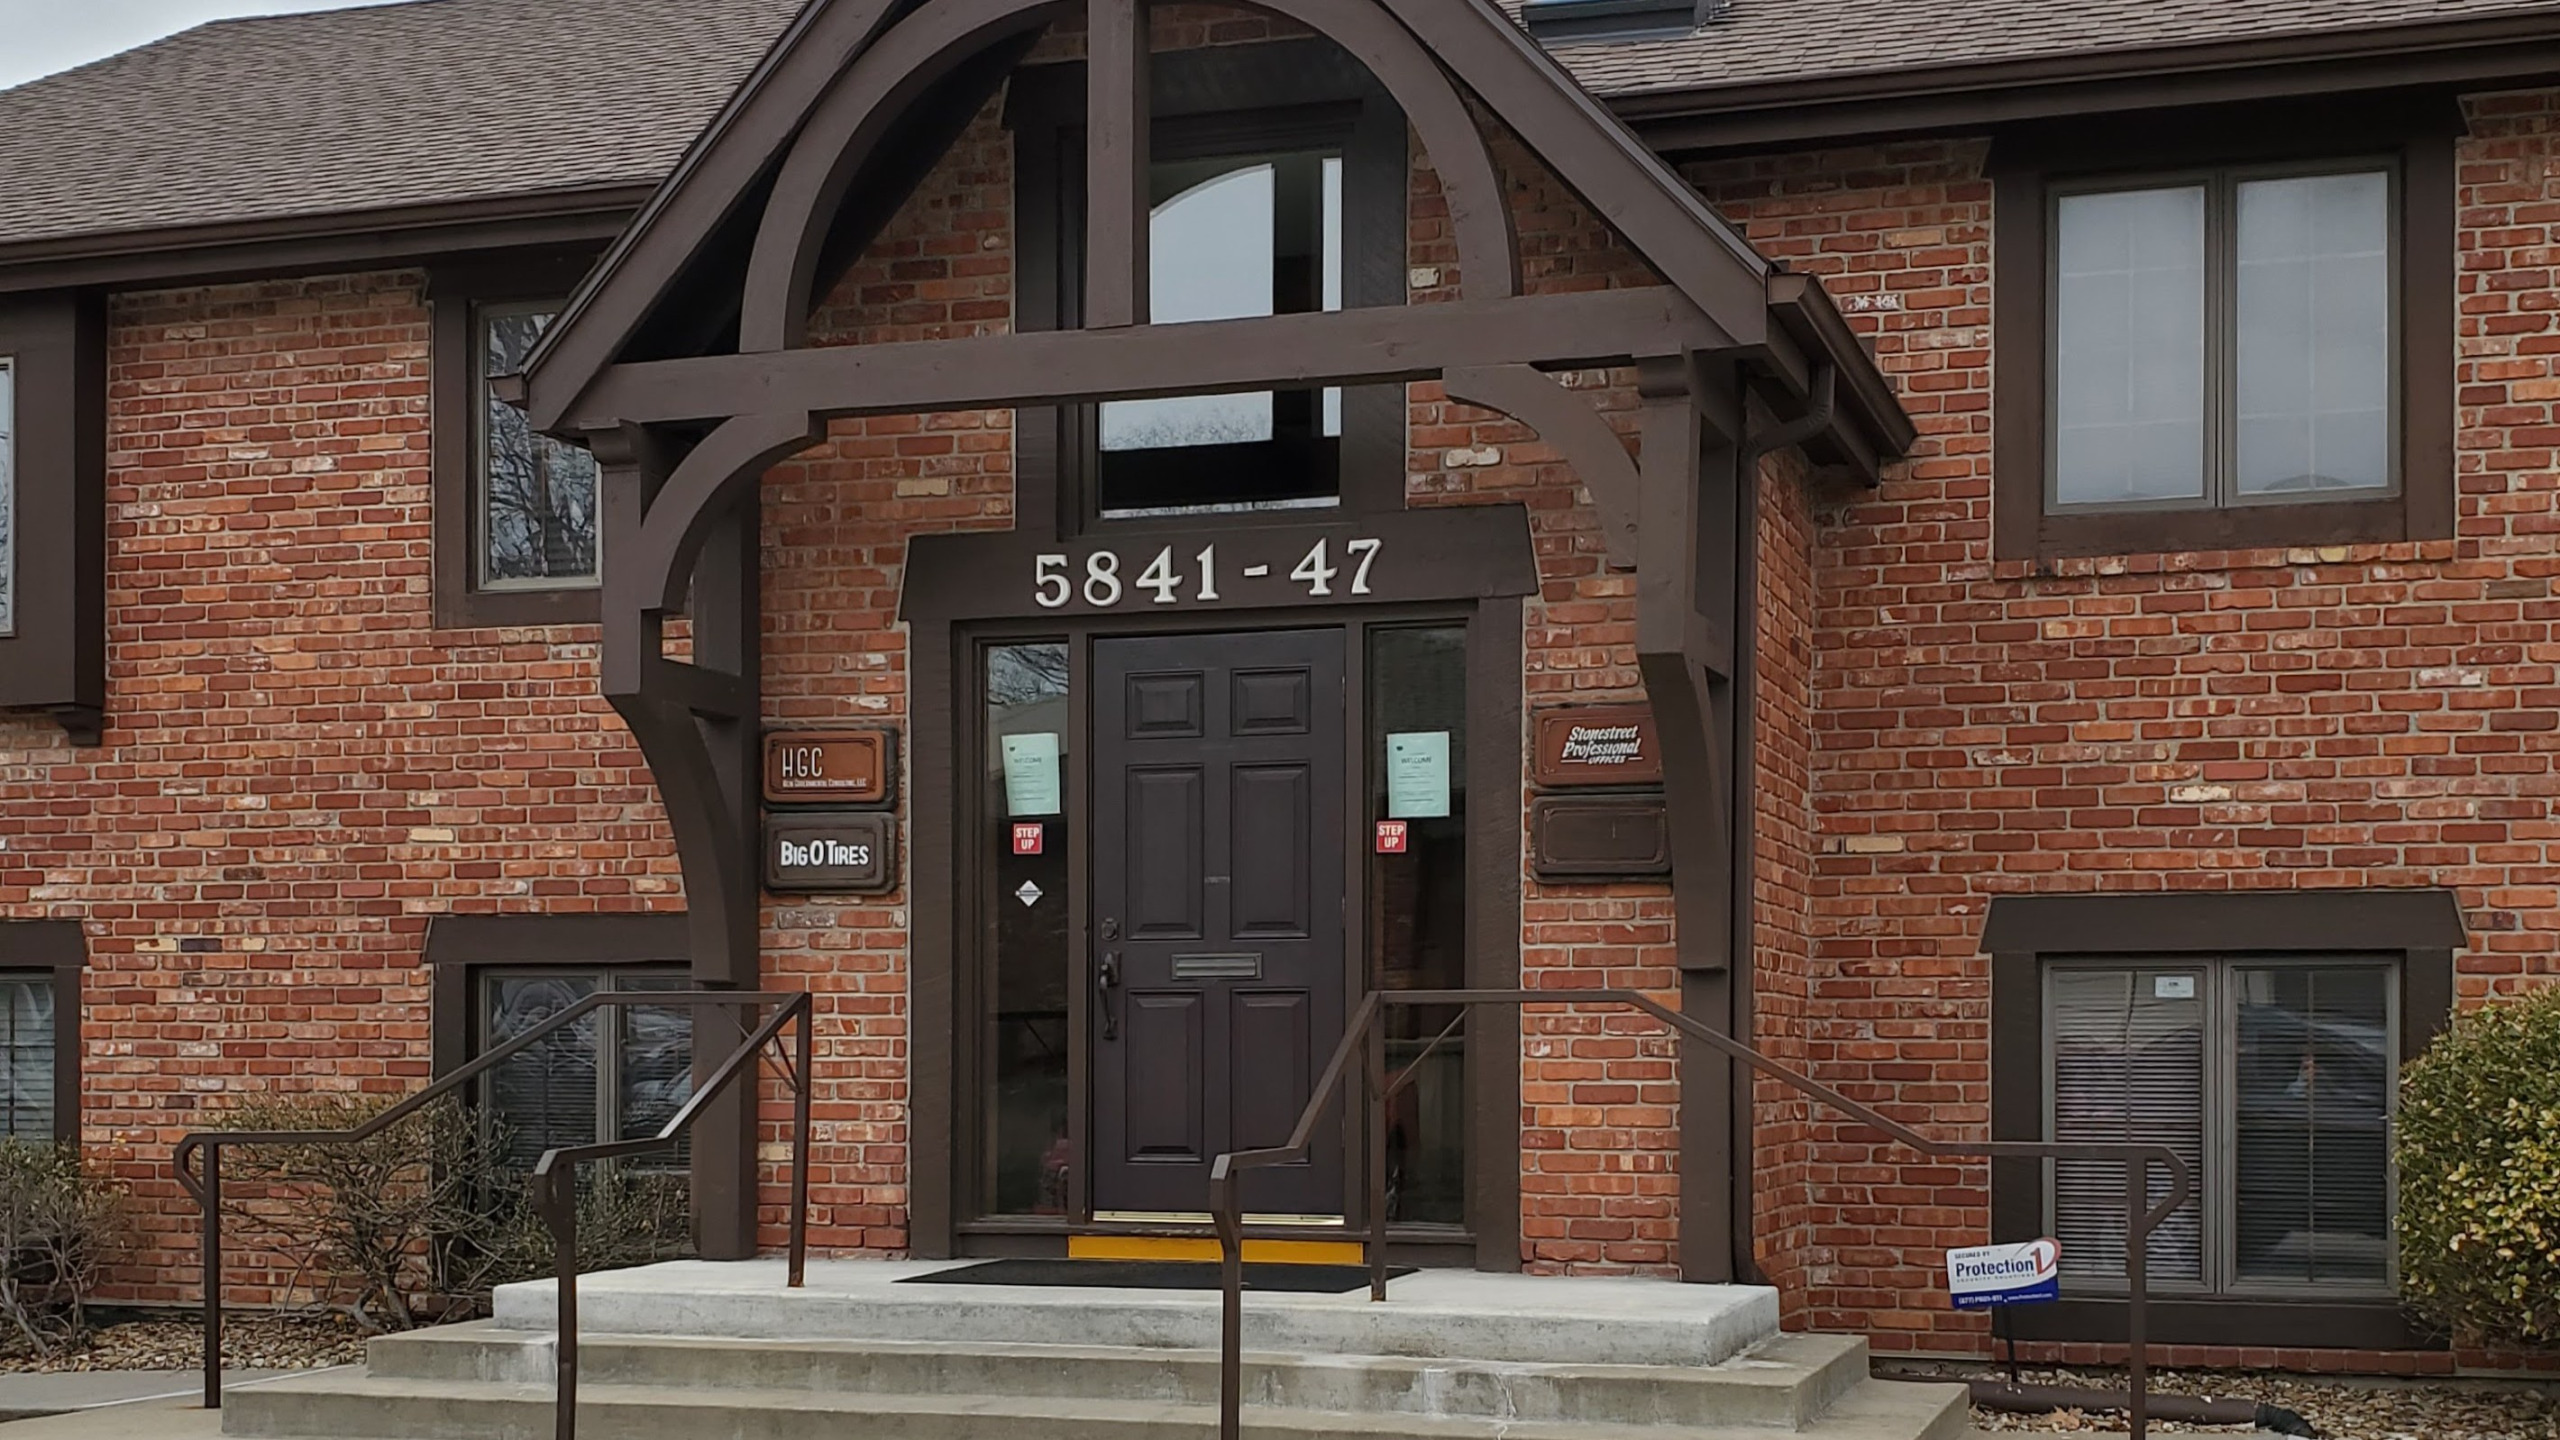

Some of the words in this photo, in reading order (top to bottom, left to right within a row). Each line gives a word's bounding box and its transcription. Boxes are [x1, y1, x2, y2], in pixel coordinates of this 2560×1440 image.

[1569, 725, 1638, 741] Stonestreet
[1562, 737, 1641, 759] Professional
[781, 747, 823, 777] HGC
[1588, 755, 1625, 765] OFFICES
[1015, 827, 1040, 839] STEP
[1378, 825, 1404, 836] STEP
[1021, 839, 1034, 850] UP
[1384, 837, 1399, 848] UP
[780, 841, 808, 866] BIG
[809, 840, 824, 866] O
[825, 840, 869, 866] TIRES
[1955, 1251, 1981, 1259] SECURED
[1956, 1258, 2035, 1278] Protection
